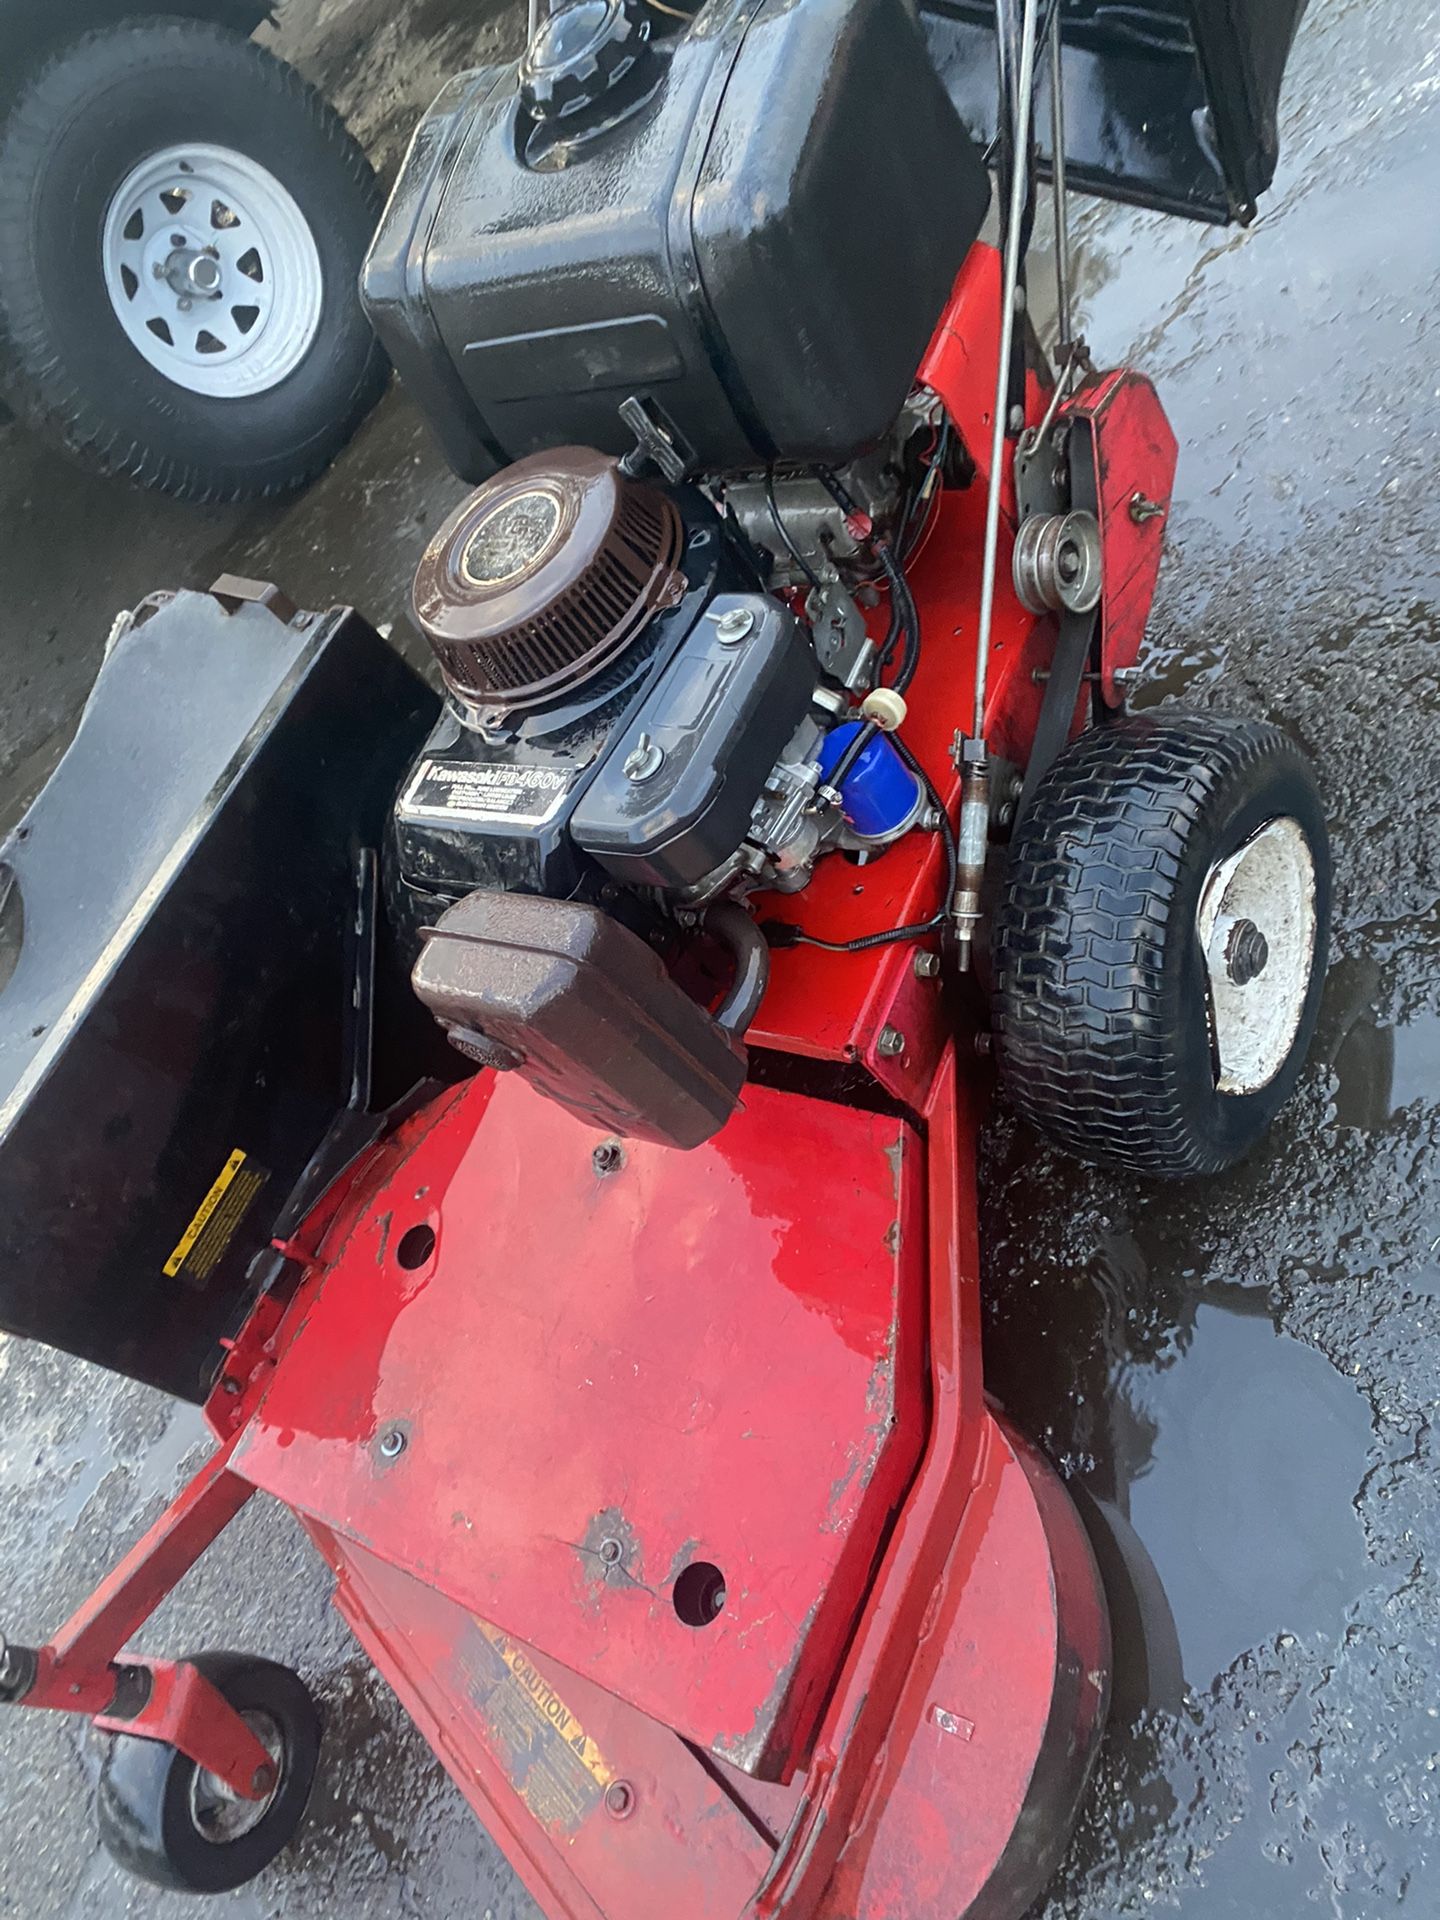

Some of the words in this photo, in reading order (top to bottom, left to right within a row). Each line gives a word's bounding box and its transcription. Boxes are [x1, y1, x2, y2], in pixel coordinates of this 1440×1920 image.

[426, 766, 499, 786] Kawasaki
[187, 1186, 224, 1239] CAUTION
[512, 1655, 571, 1730] CAUTION
